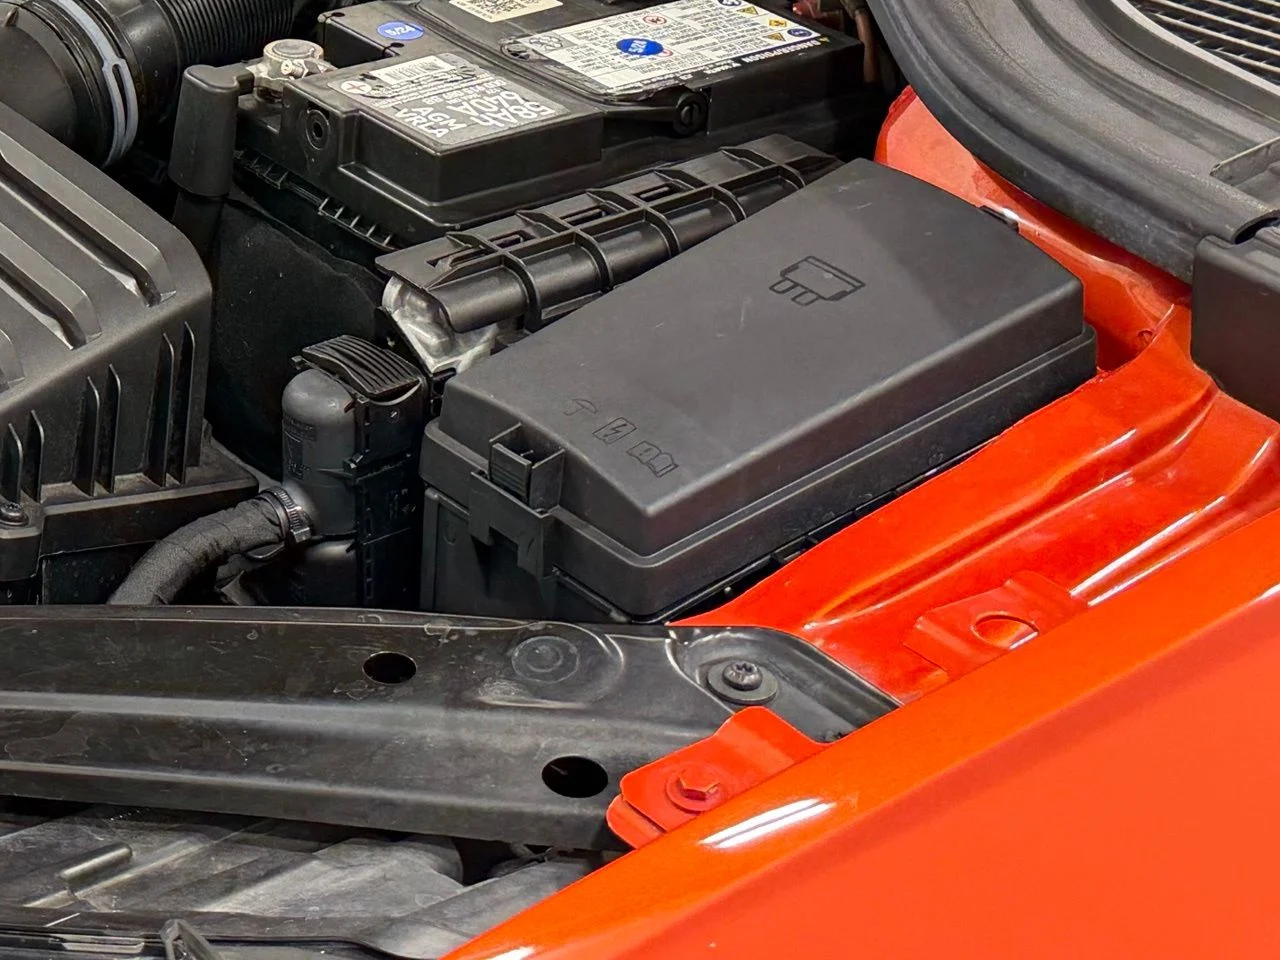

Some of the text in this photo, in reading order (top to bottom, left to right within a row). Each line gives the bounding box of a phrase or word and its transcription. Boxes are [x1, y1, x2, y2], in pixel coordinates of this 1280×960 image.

[447, 90, 525, 115] 640A
[470, 101, 556, 127] 58Ah
[394, 107, 450, 138] VRLA
[412, 106, 468, 132] AGM
